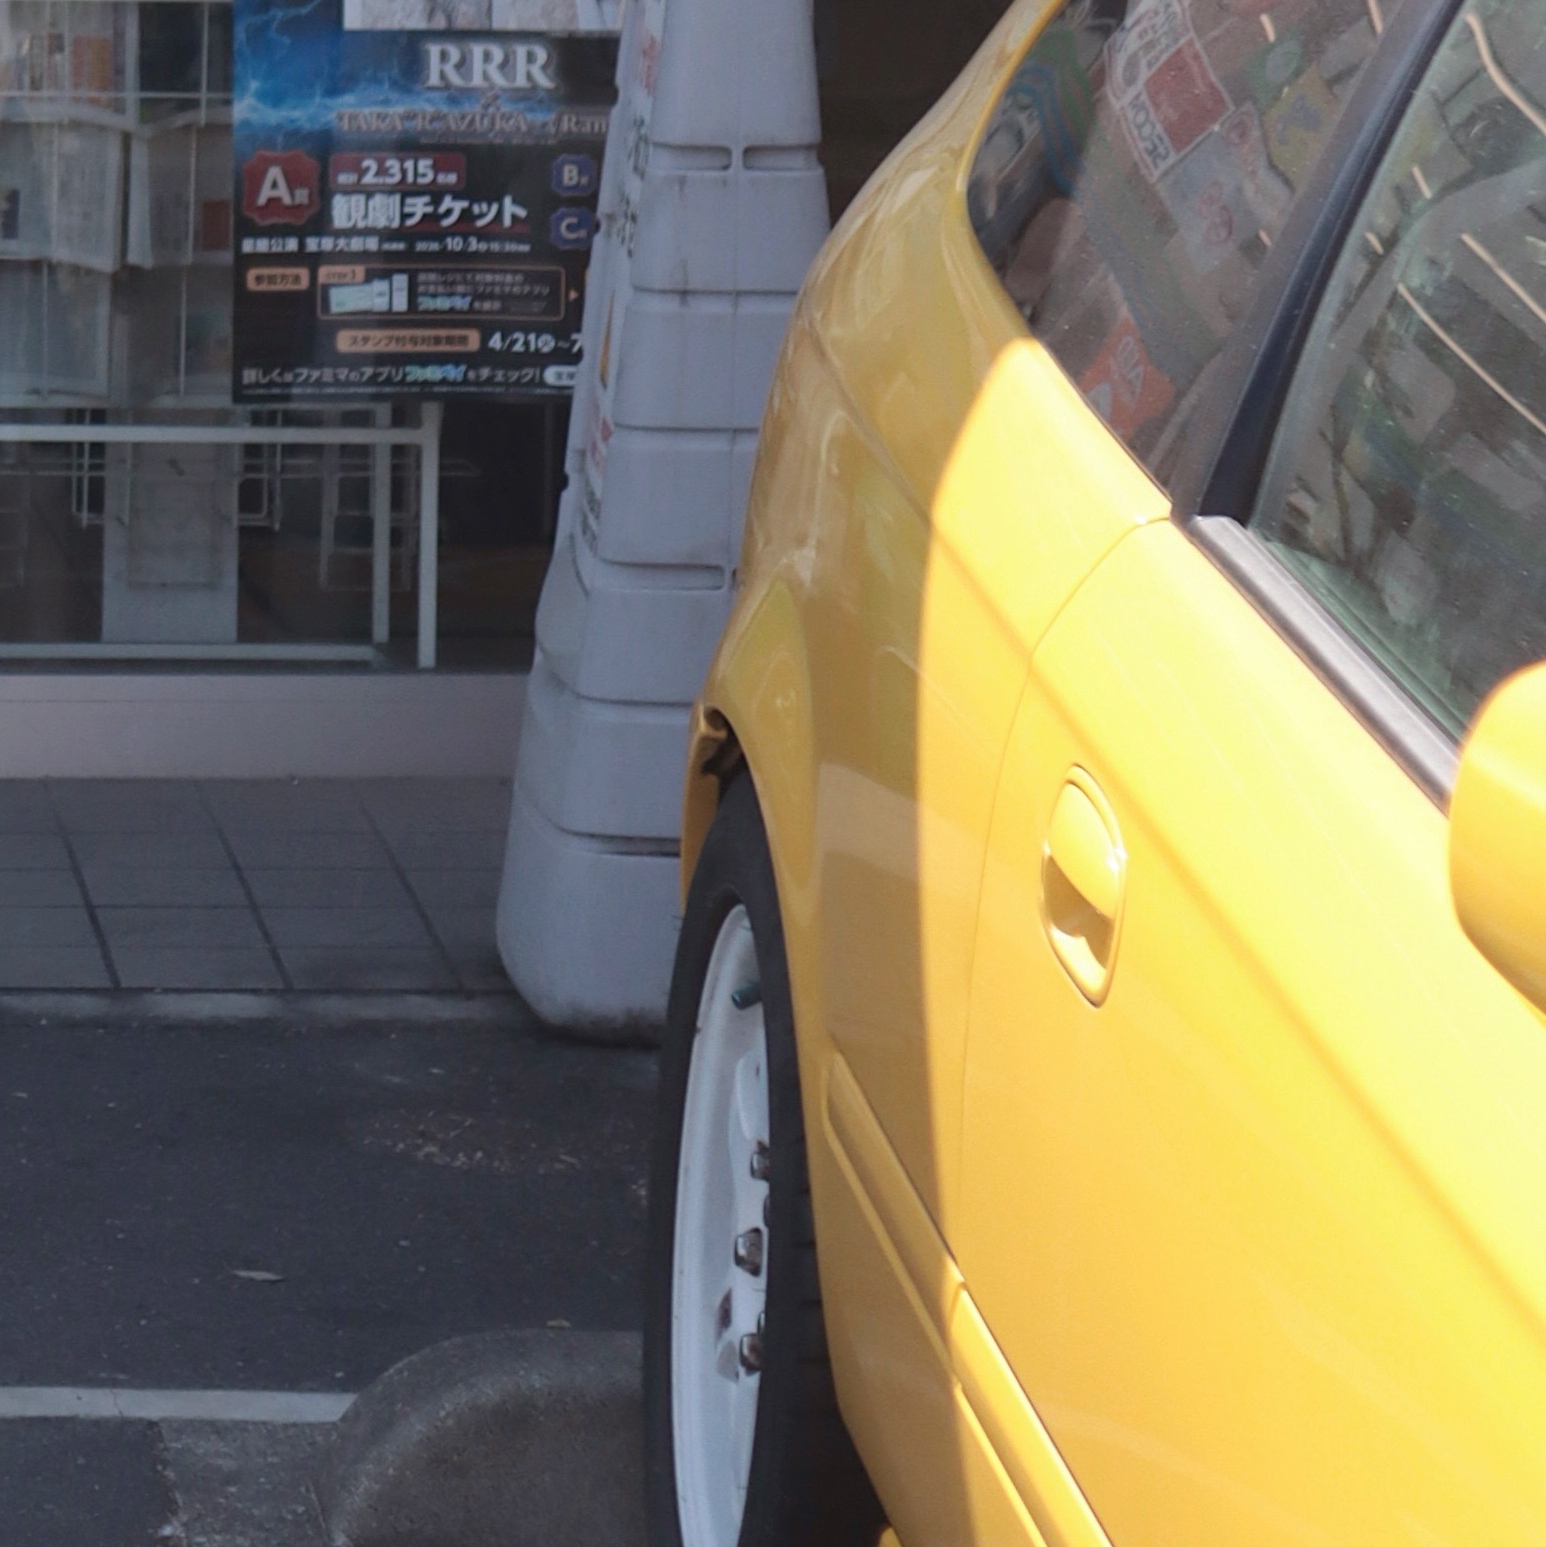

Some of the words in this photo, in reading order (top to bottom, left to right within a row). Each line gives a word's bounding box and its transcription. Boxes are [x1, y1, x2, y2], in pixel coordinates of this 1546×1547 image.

[424, 42, 555, 89] RRR
[331, 194, 529, 230] 観劇チケット
